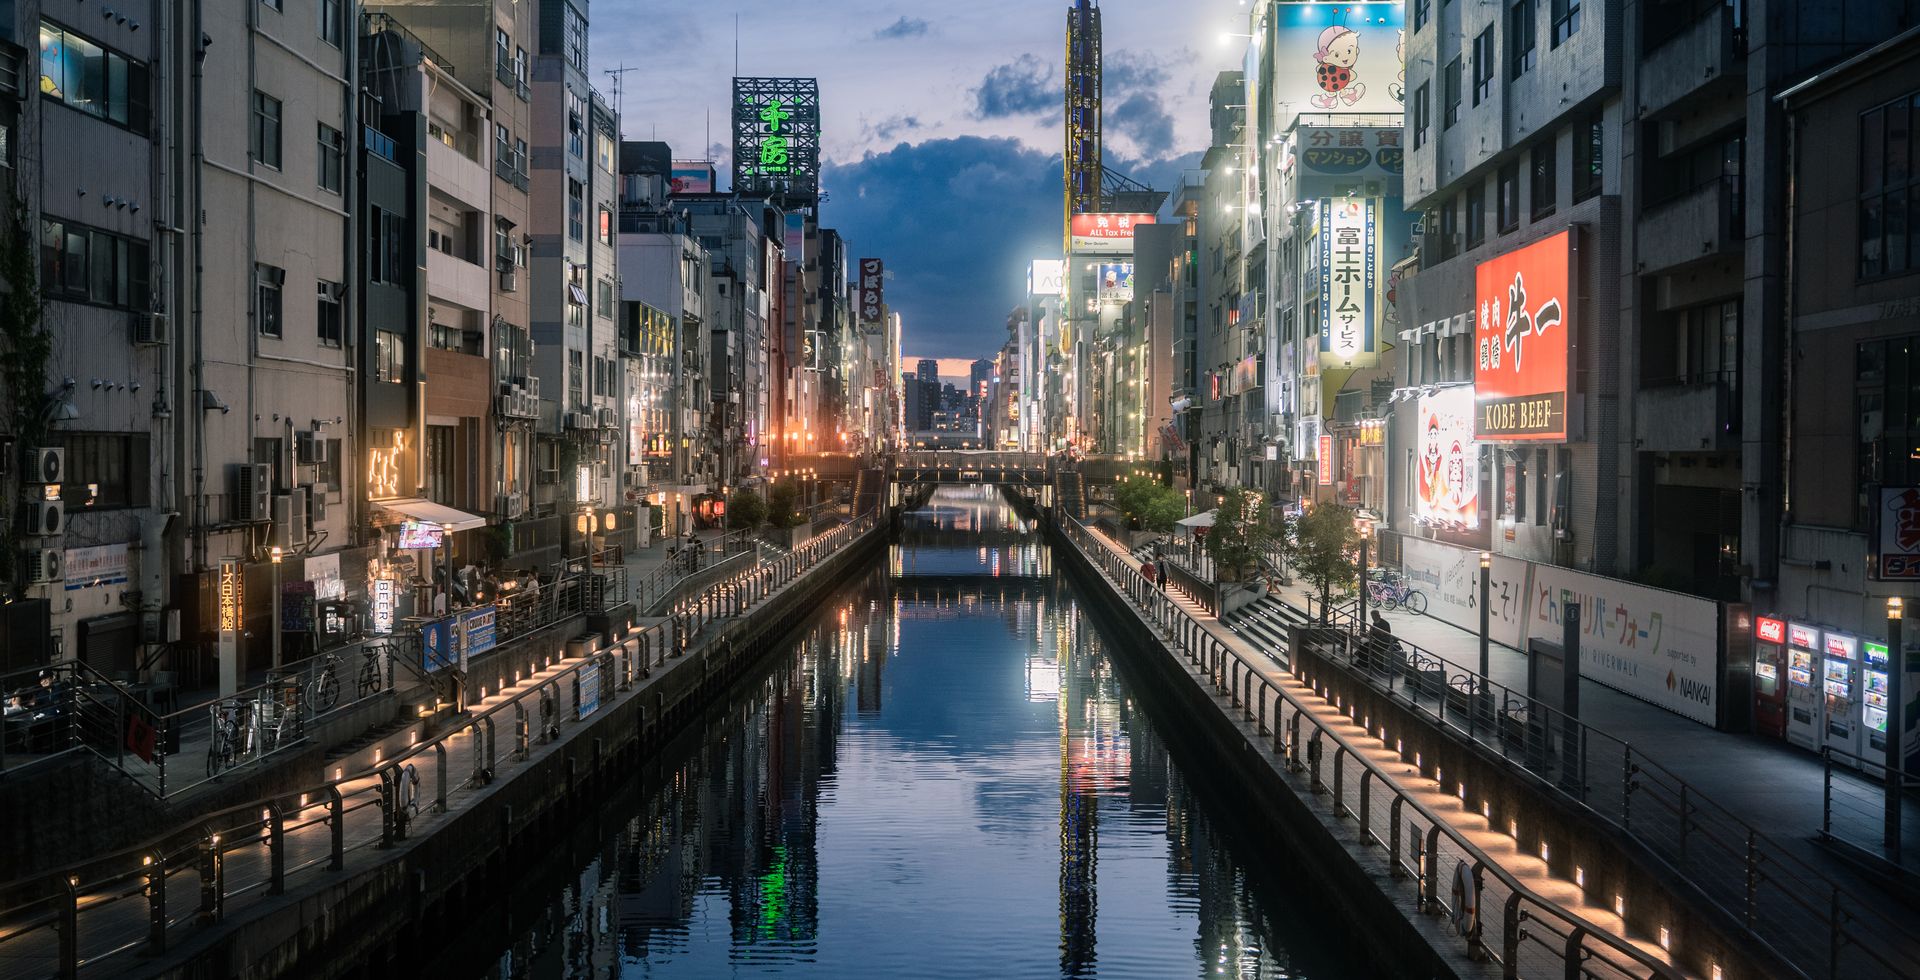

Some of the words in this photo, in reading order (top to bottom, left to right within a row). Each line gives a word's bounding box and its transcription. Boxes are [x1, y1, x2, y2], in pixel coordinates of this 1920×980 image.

[761, 100, 789, 164] 千房
[1307, 151, 1368, 165] マンション
[1105, 229, 1118, 237] Tax
[1485, 404, 1516, 430] KOBE
[1520, 399, 1551, 429] BEEF
[378, 582, 389, 620] BEER
[1593, 648, 1638, 678] RIVERWALK
[1680, 677, 1711, 705] NANKAI
